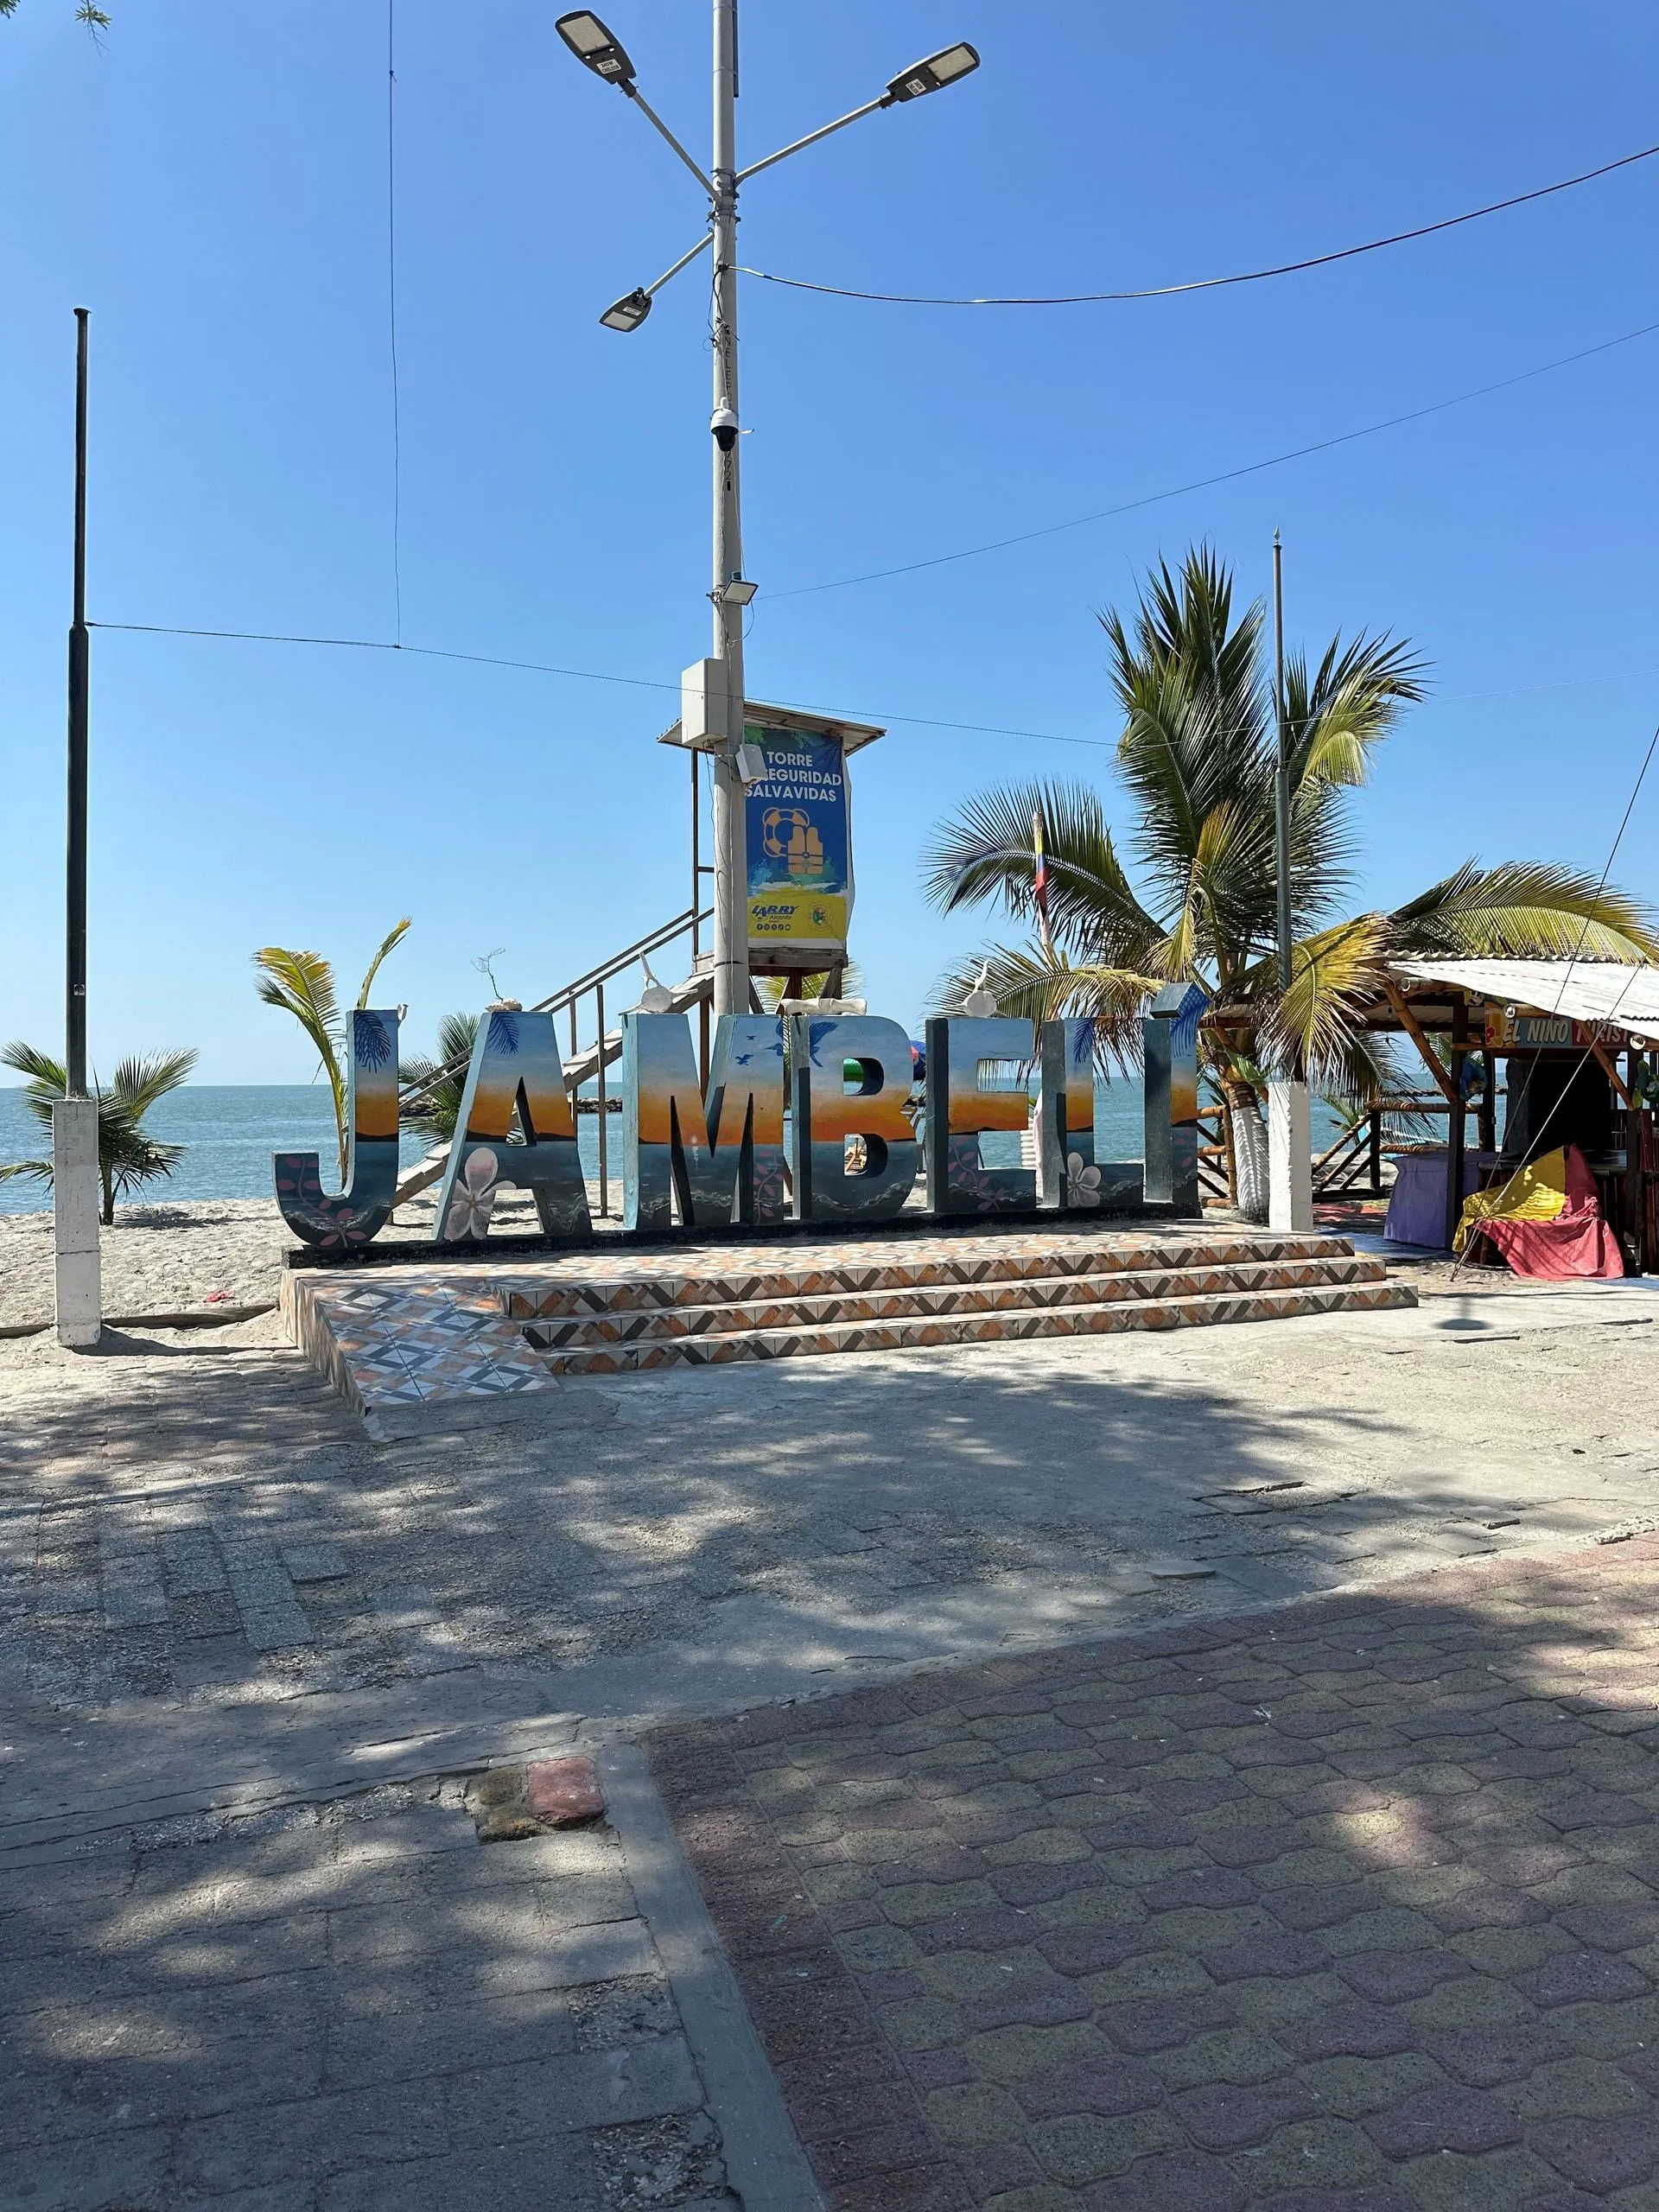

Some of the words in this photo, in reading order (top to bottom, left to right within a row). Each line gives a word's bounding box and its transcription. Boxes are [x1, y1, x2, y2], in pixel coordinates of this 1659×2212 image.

[767, 752, 813, 766] TORRE
[766, 768, 842, 785] EGURIDAD
[746, 785, 837, 802] SALVAVIDAS
[752, 906, 799, 917] LARRY
[1503, 1020, 1521, 1043] EL
